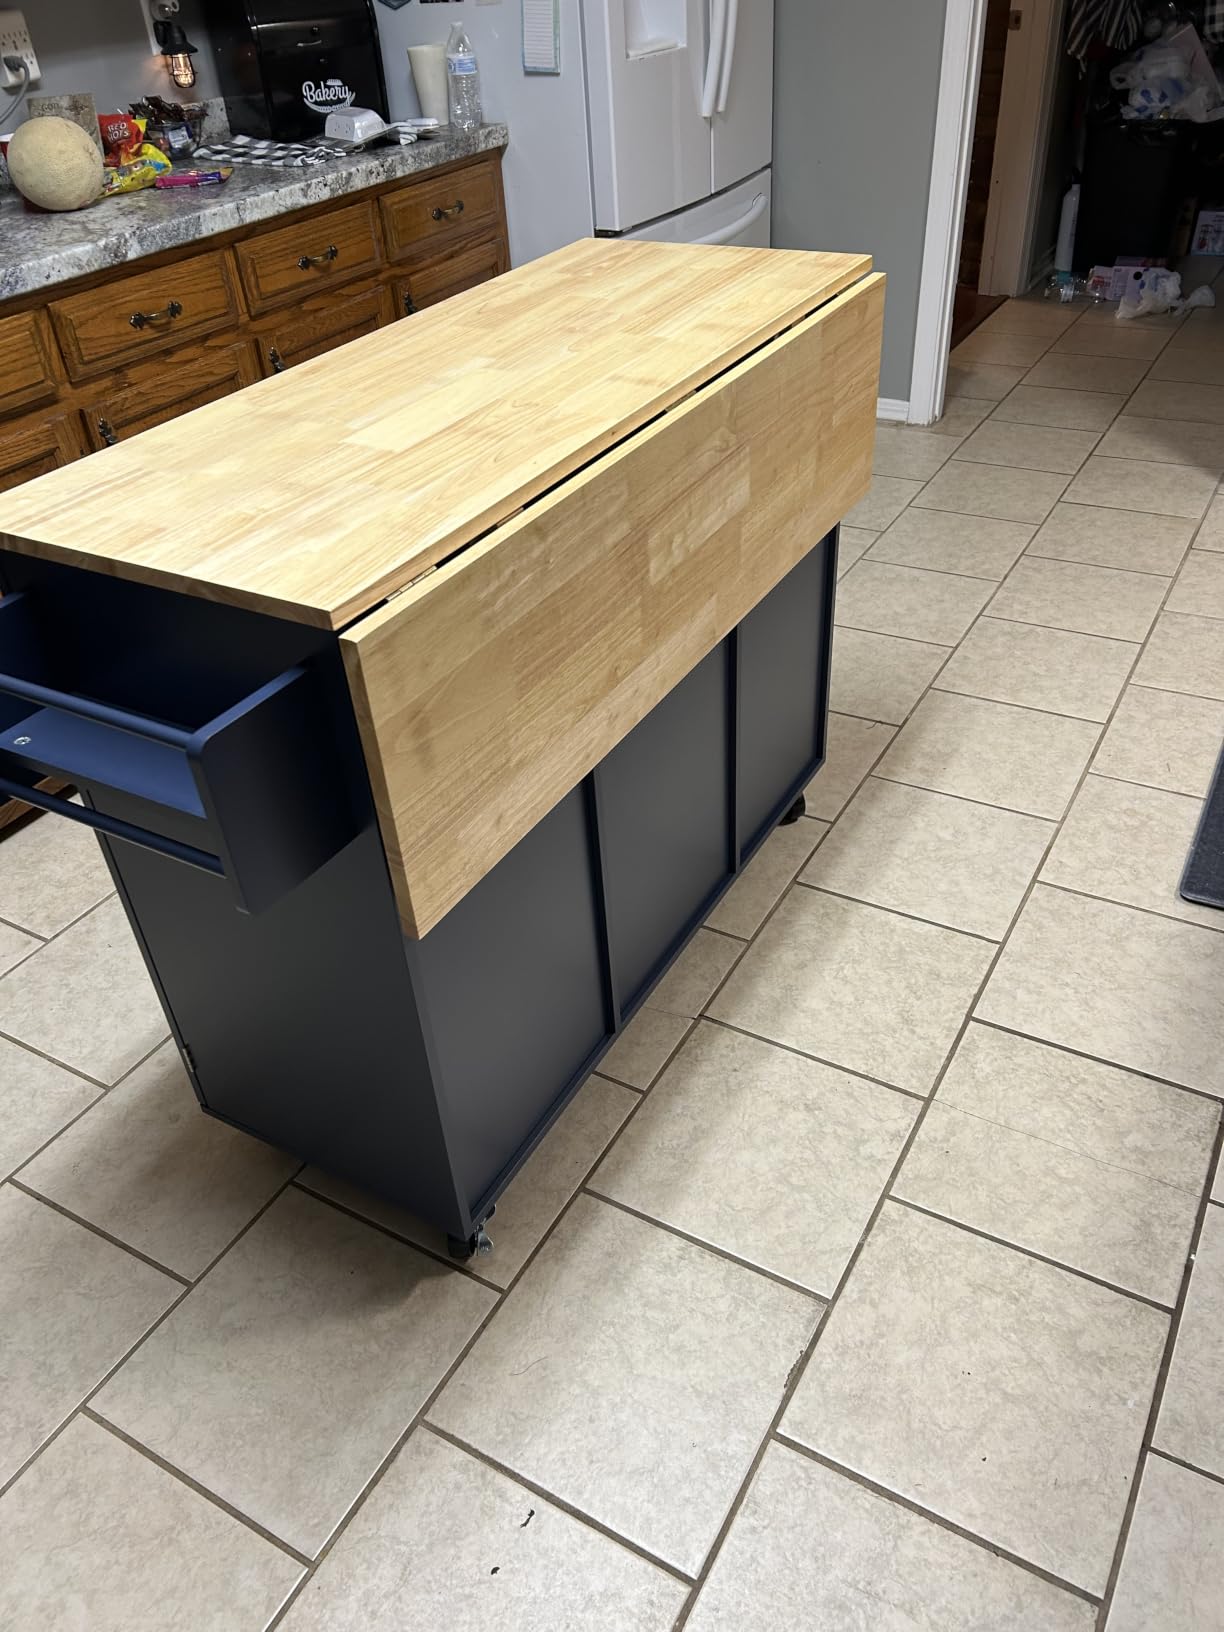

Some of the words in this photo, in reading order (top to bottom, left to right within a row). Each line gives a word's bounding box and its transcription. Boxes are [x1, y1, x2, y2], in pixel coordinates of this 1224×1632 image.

[302, 81, 351, 106] Bakery
[107, 122, 127, 133] RED
[107, 129, 130, 143] HOTS
